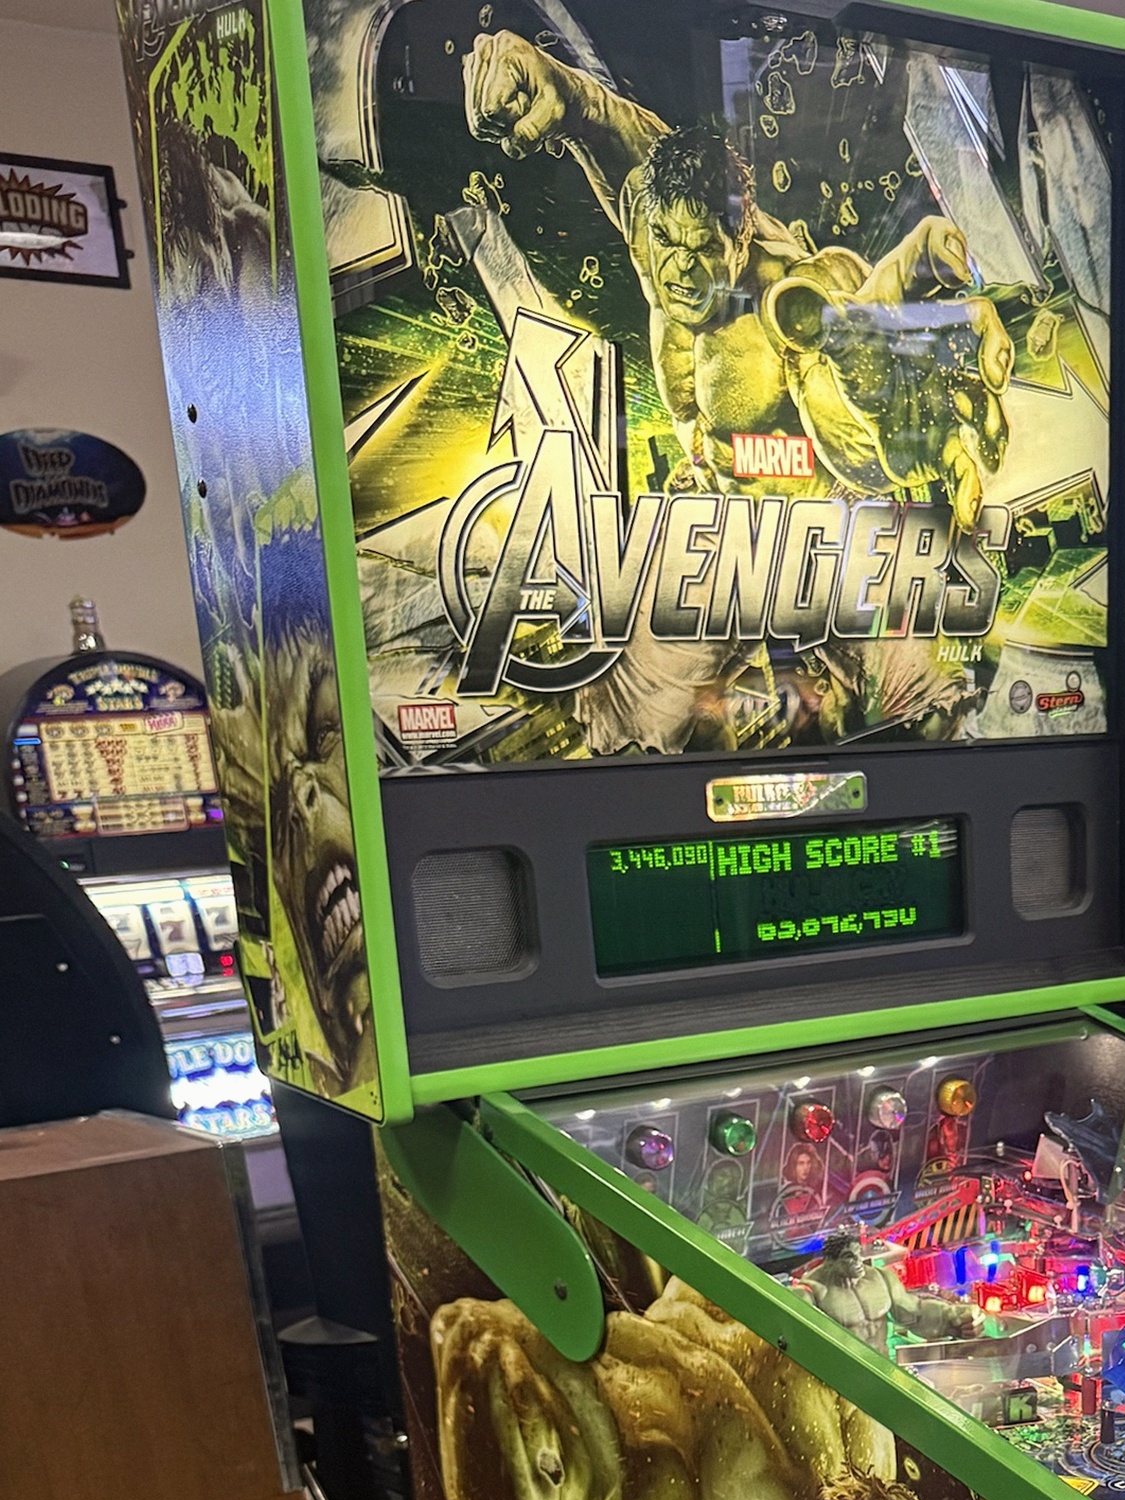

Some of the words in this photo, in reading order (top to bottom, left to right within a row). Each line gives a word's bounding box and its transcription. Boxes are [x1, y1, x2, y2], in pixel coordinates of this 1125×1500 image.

[734, 435, 814, 478] MARVEL
[439, 429, 1011, 698] AVENGERS
[520, 588, 555, 611] THE
[936, 645, 983, 662] HULK
[1038, 694, 1081, 710] Stern
[401, 706, 455, 731] MARVEL
[610, 844, 708, 874] 3,446,090
[718, 841, 792, 878] HIGH
[806, 833, 899, 870] SCORE
[911, 830, 942, 859] #1
